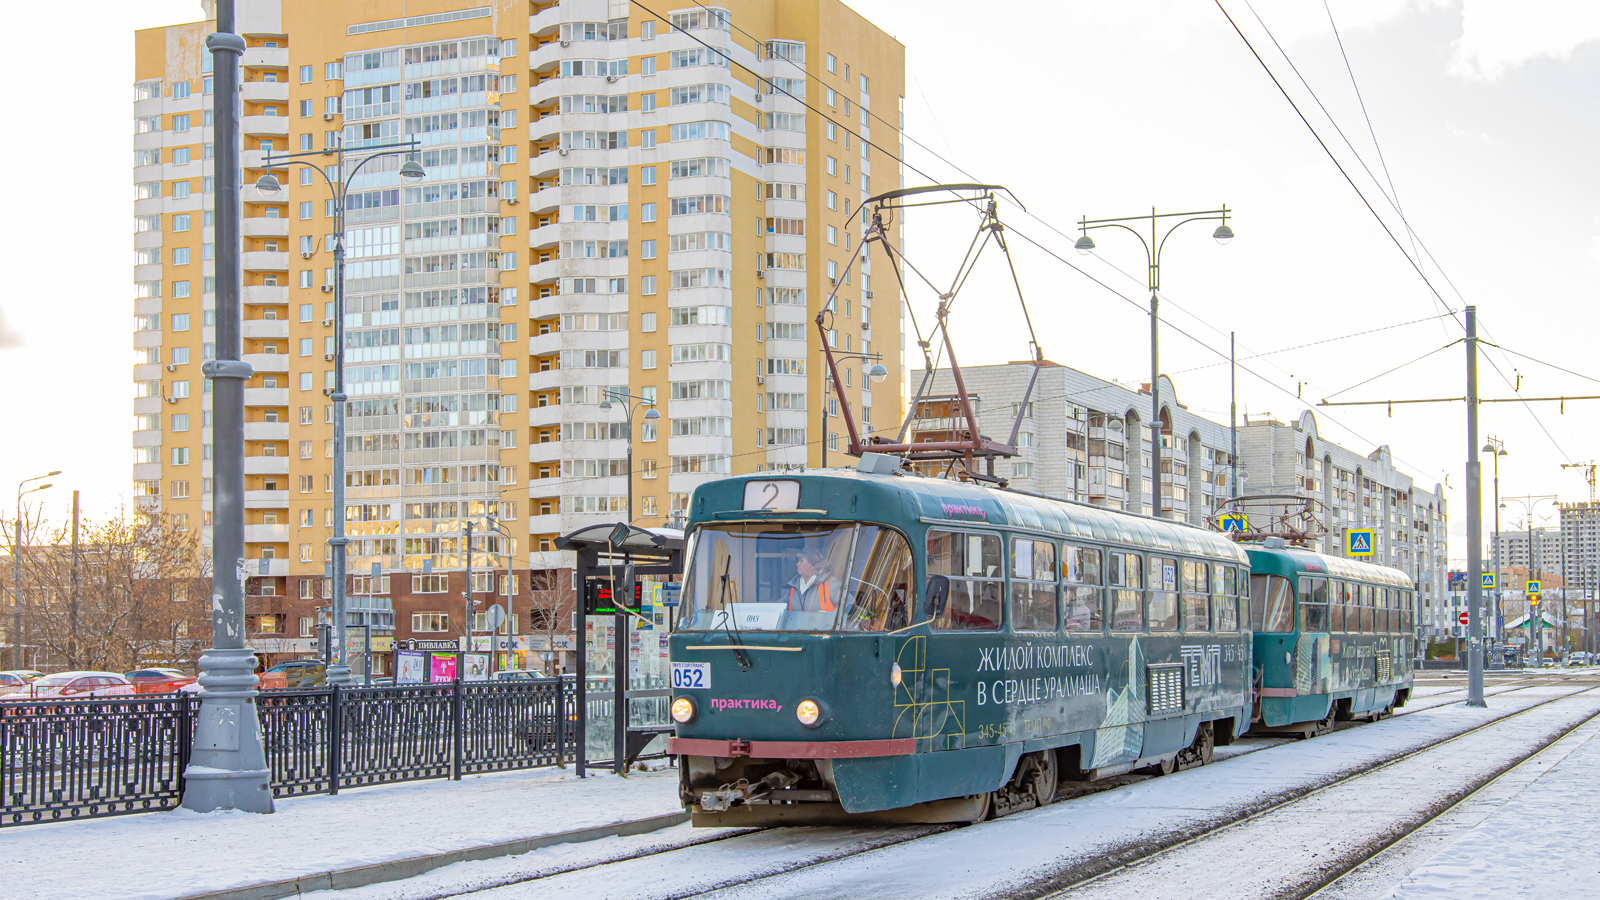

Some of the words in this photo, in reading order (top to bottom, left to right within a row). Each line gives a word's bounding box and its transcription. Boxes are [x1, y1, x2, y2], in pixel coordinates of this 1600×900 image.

[761, 483, 779, 510] 2
[977, 642, 1033, 671] ЖИЛОЙ
[1037, 645, 1094, 668] КОМПЛЕКС
[674, 668, 703, 687] 052
[978, 682, 987, 705] В
[992, 678, 1041, 705] СЕРДЦЕ
[1044, 674, 1101, 699] УРАЛМАША
[711, 698, 783, 712] практика,
